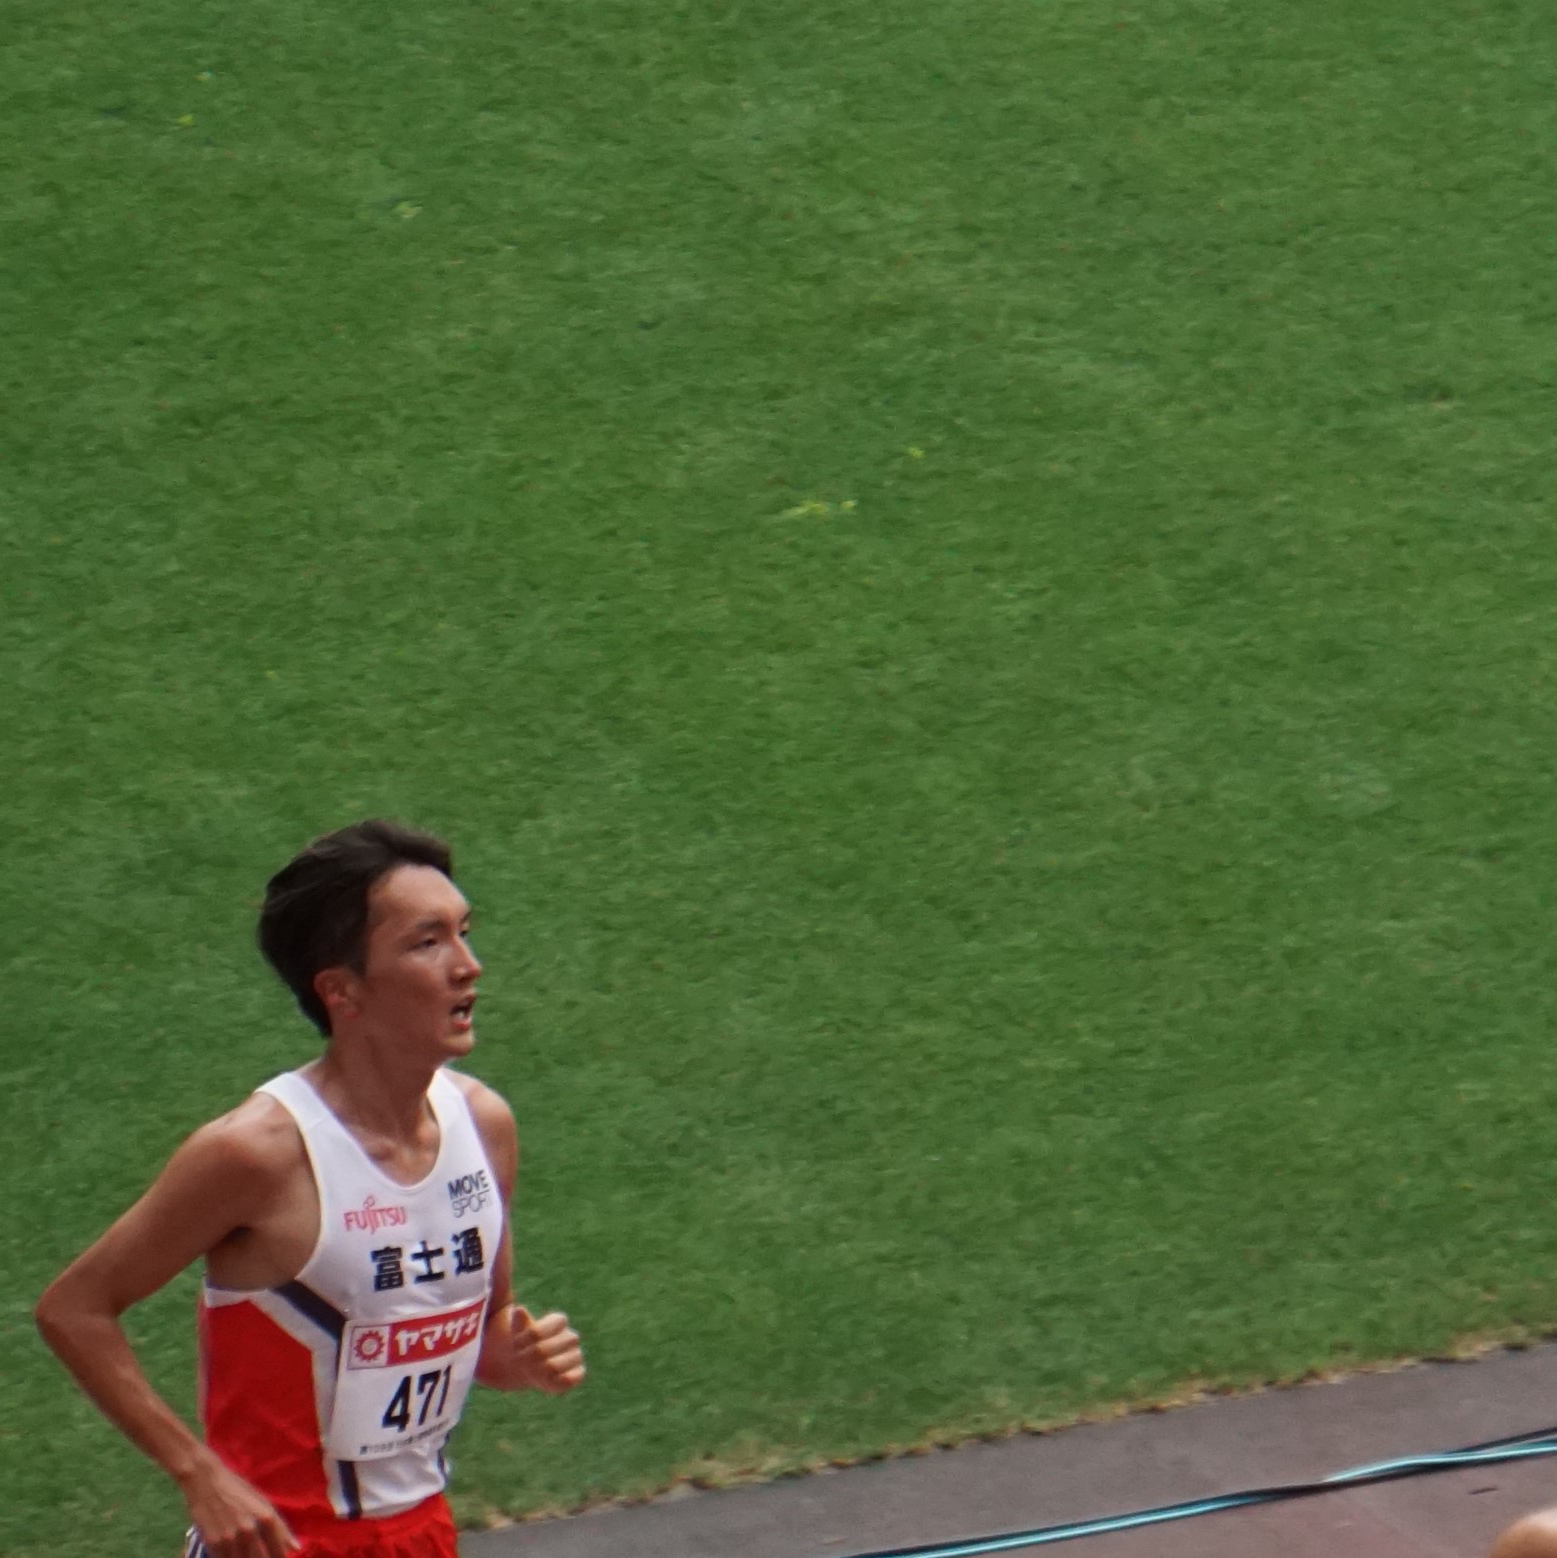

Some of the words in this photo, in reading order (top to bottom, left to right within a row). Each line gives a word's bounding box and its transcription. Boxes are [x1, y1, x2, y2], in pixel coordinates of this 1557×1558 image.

[447, 1169, 488, 1200] MOVE
[343, 1200, 406, 1235] FUJITSU
[369, 1226, 485, 1292] 富士通
[381, 1365, 452, 1432] 471
